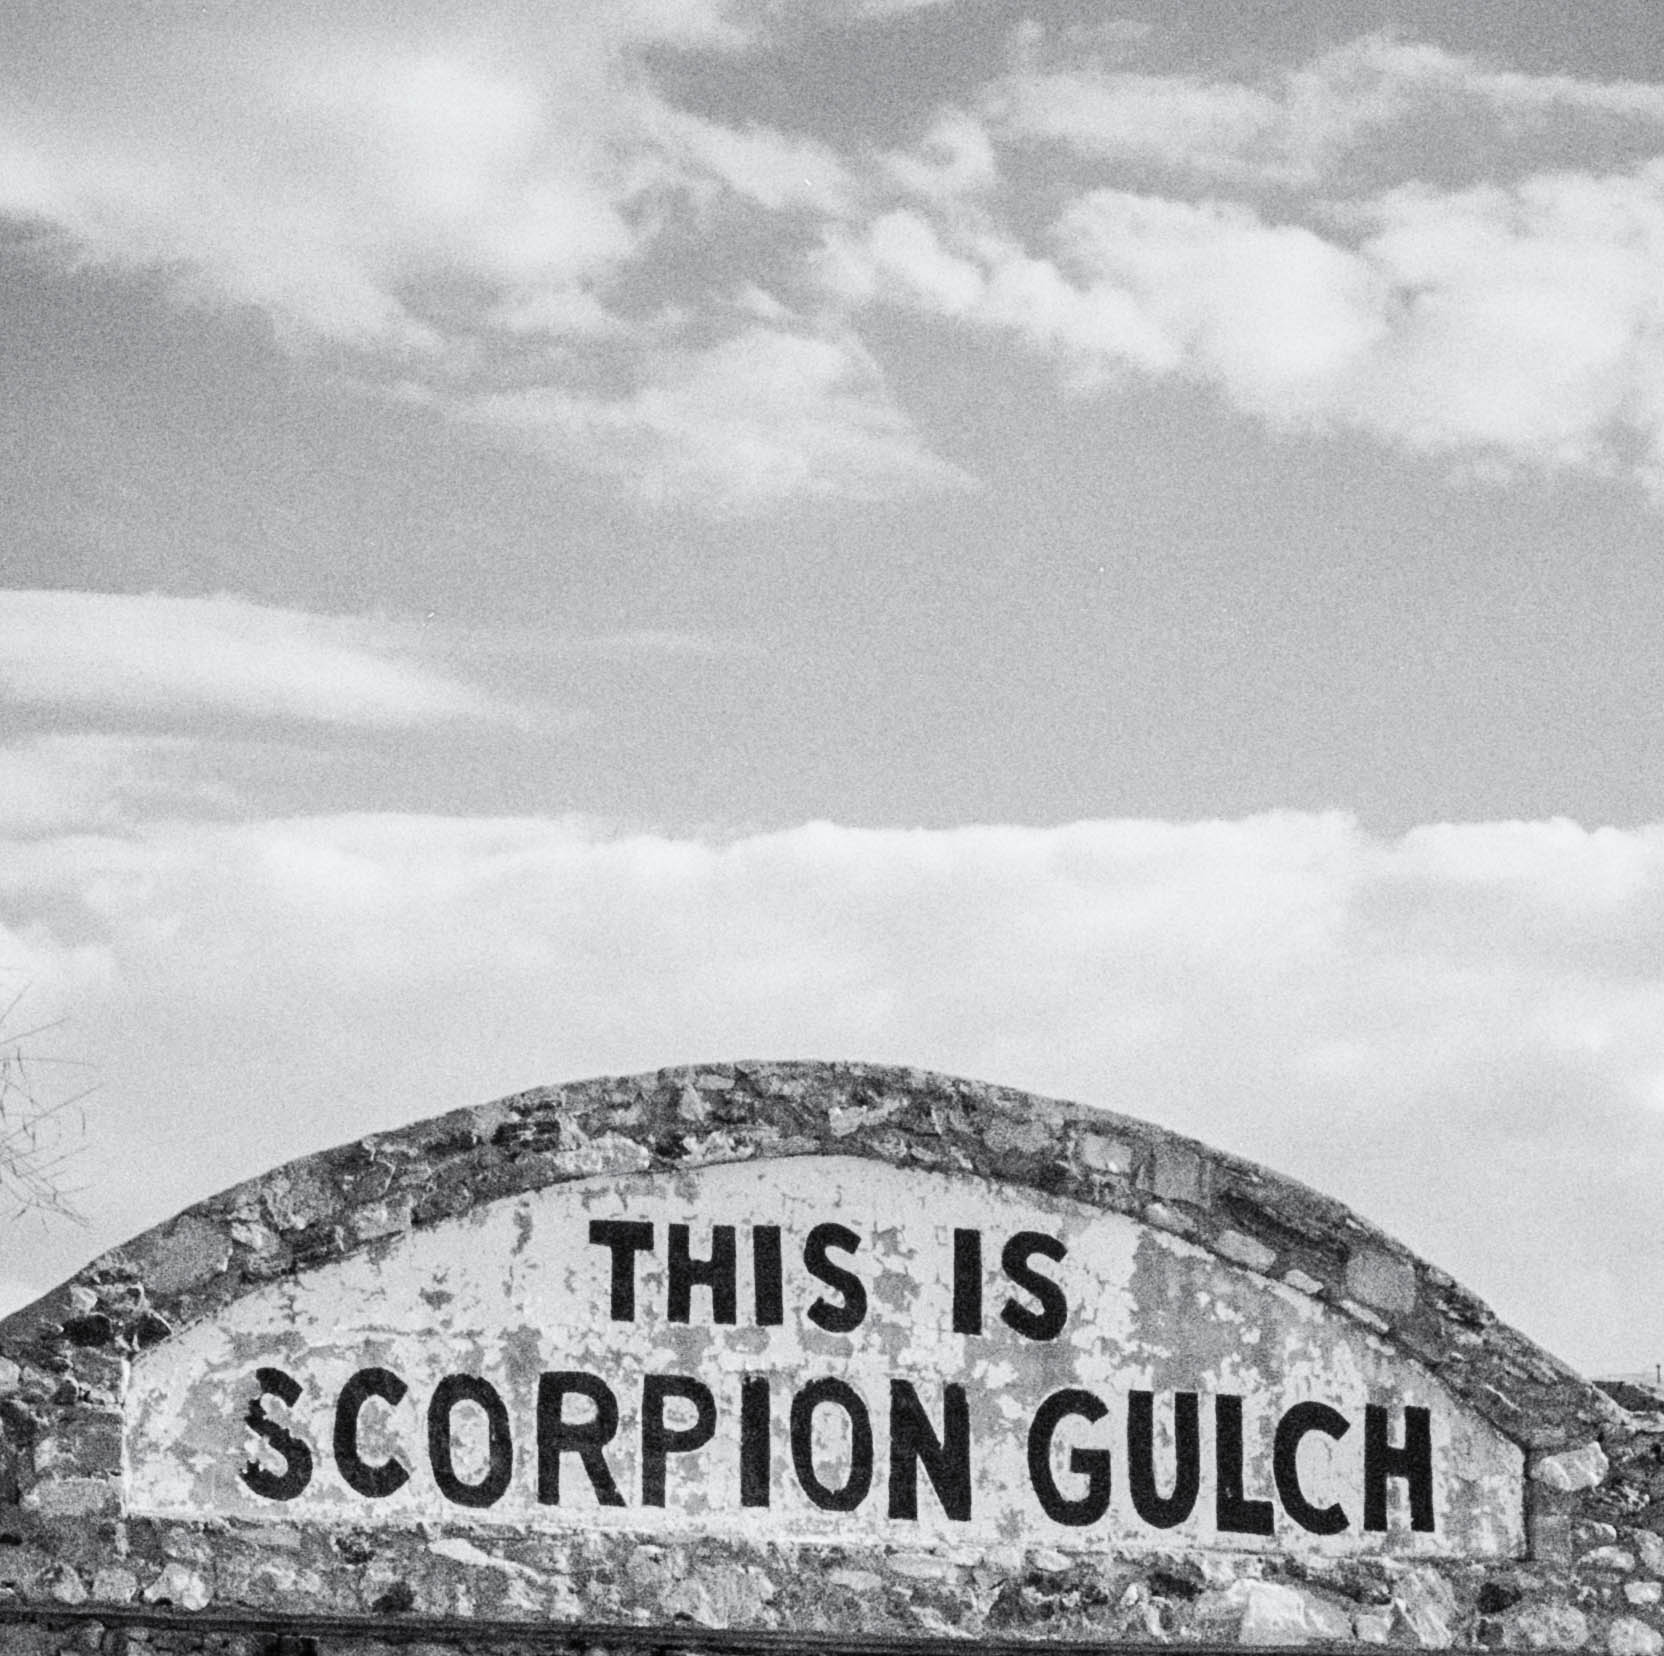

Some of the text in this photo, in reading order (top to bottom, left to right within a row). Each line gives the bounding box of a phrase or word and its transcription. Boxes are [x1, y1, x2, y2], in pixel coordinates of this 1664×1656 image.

[588, 1219, 1069, 1342] THIS IS
[238, 1367, 1435, 1535] SCORPION GULCH
